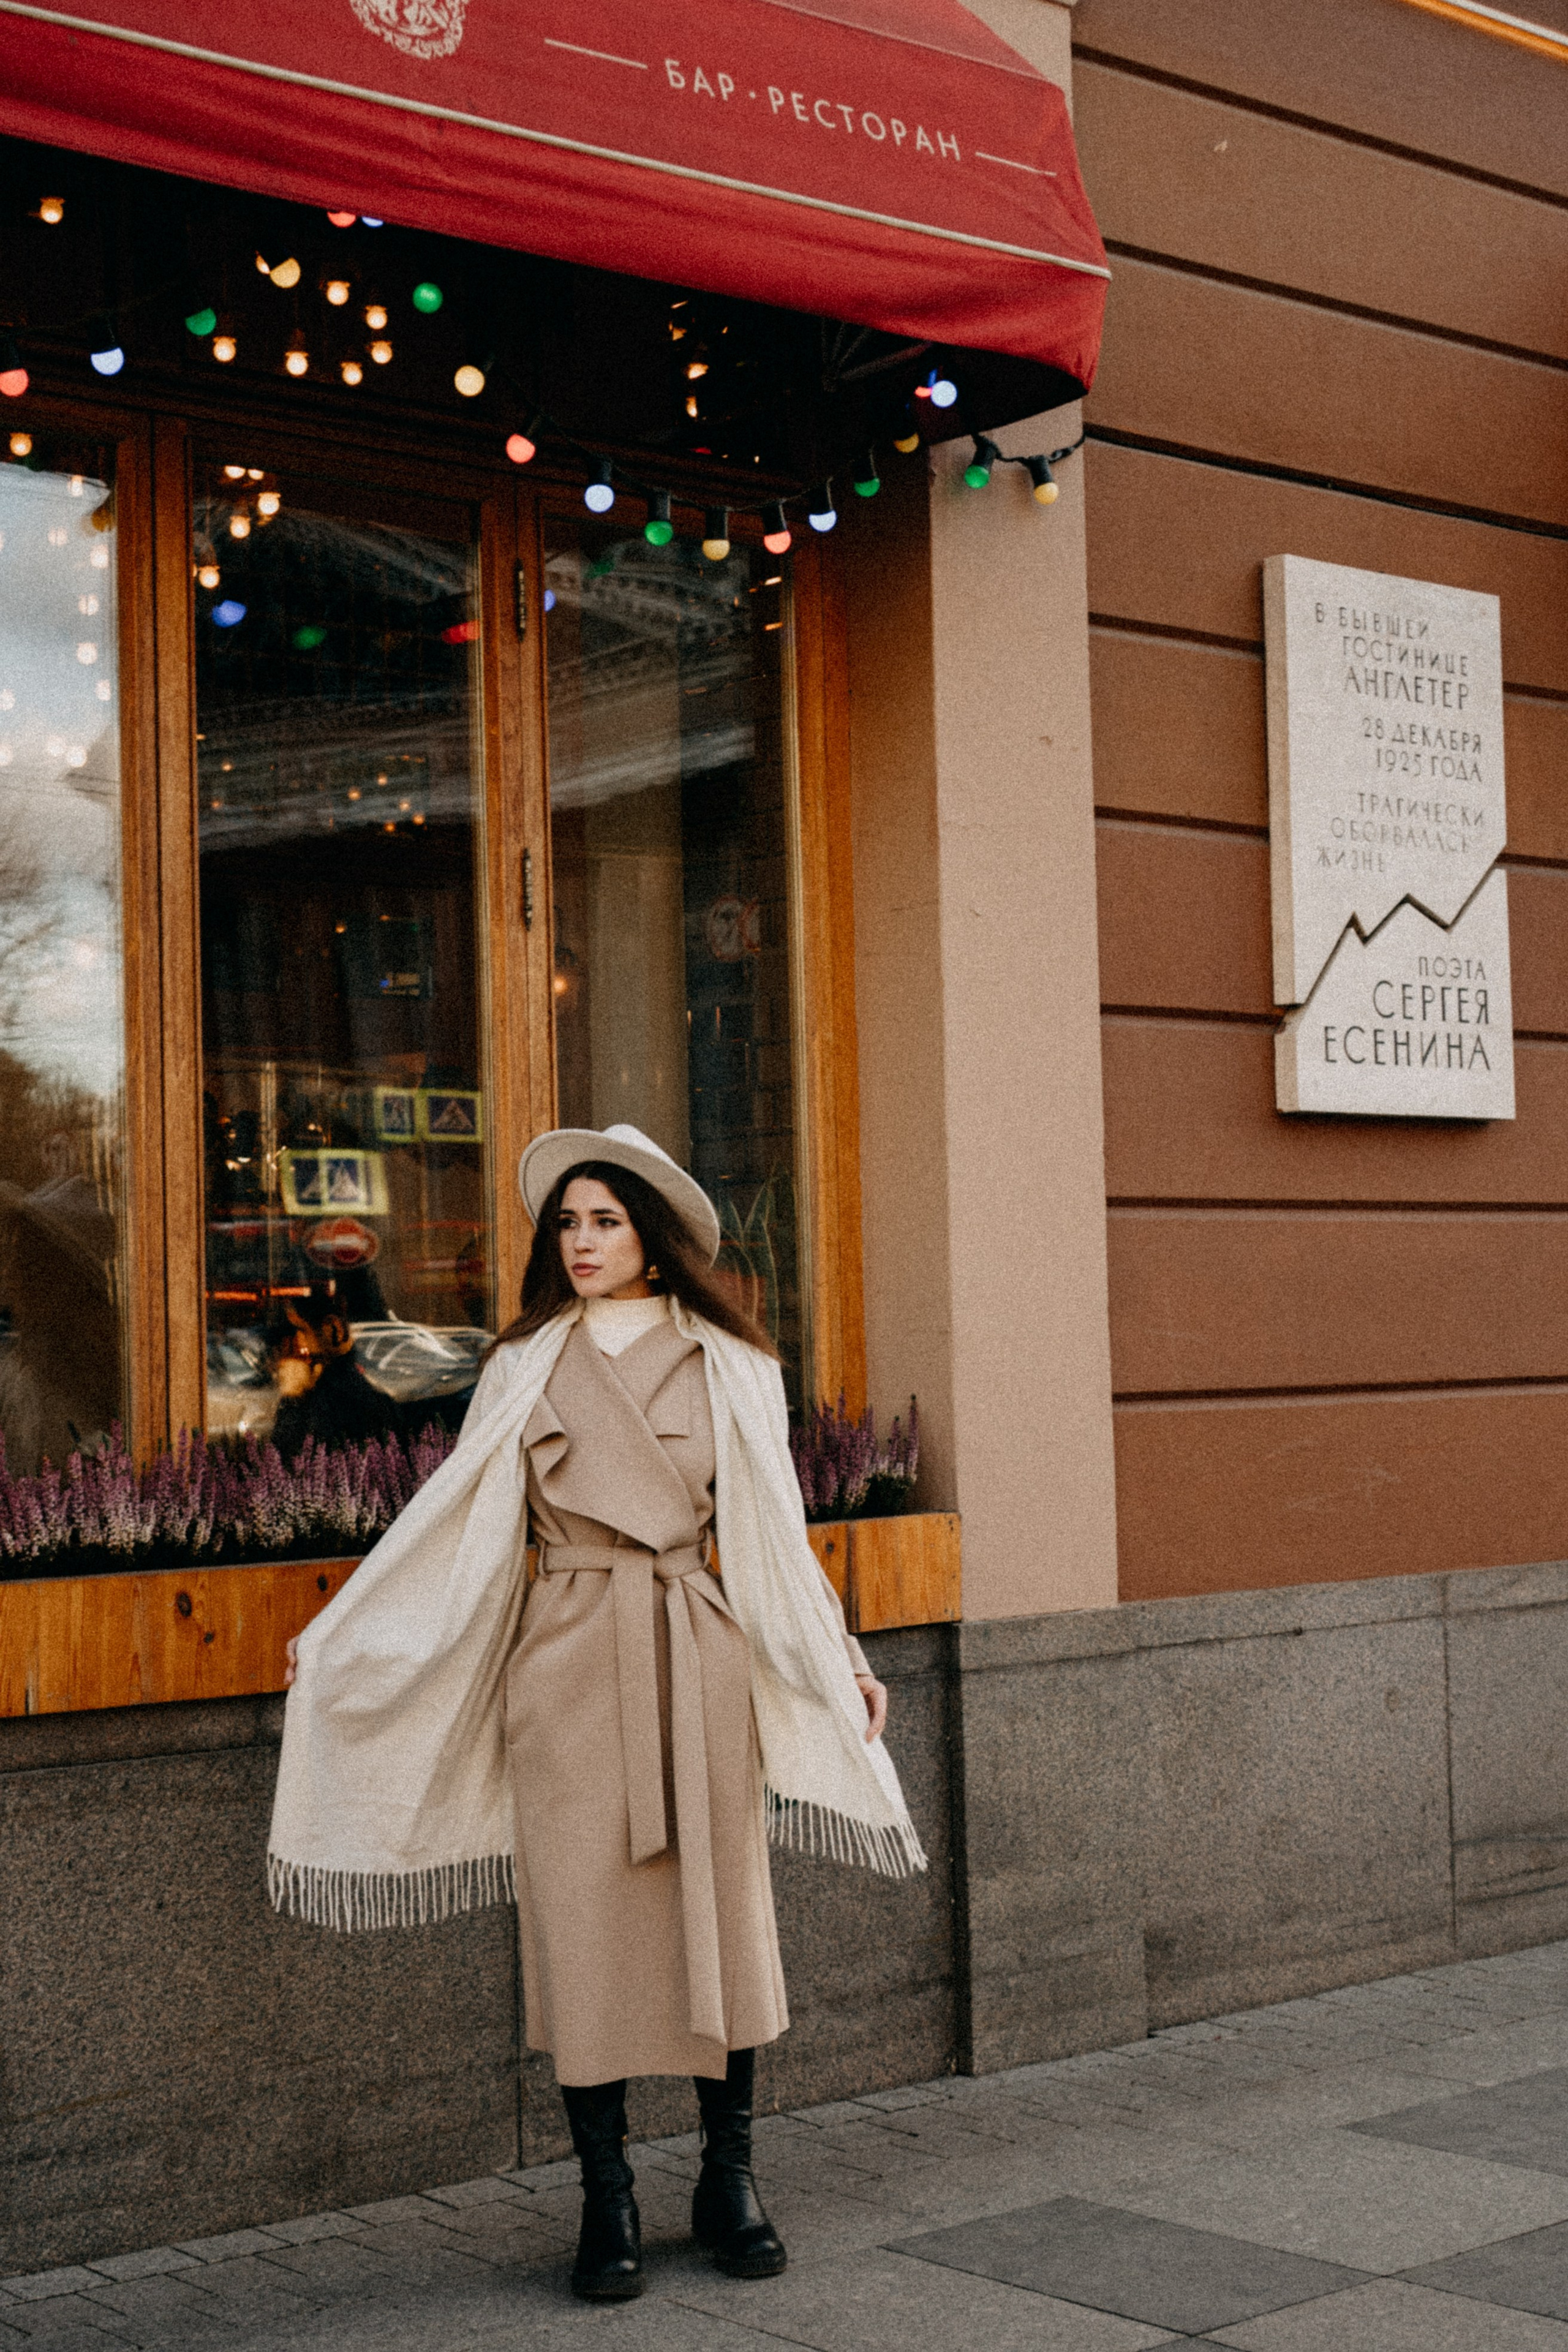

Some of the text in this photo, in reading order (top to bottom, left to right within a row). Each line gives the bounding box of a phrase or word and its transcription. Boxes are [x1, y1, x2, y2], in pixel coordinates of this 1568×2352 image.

[665, 59, 961, 161] БАР РЕСТОРАН
[1314, 602, 1325, 624] В
[1342, 635, 1469, 677] ГОСТИНИЦЕ
[1344, 665, 1469, 710] АНГЛЕТЕР
[1362, 716, 1482, 754] 28 ДЕКАБРЯ
[1376, 748, 1482, 783] 1925 ГОДА
[1357, 792, 1485, 827] ТРАГИЧЕСКИ
[1419, 956, 1487, 981] ПОЭТА
[1373, 981, 1489, 1025] СЕРГЕЯ
[1324, 1025, 1490, 1071] ЕСЕНИНА
